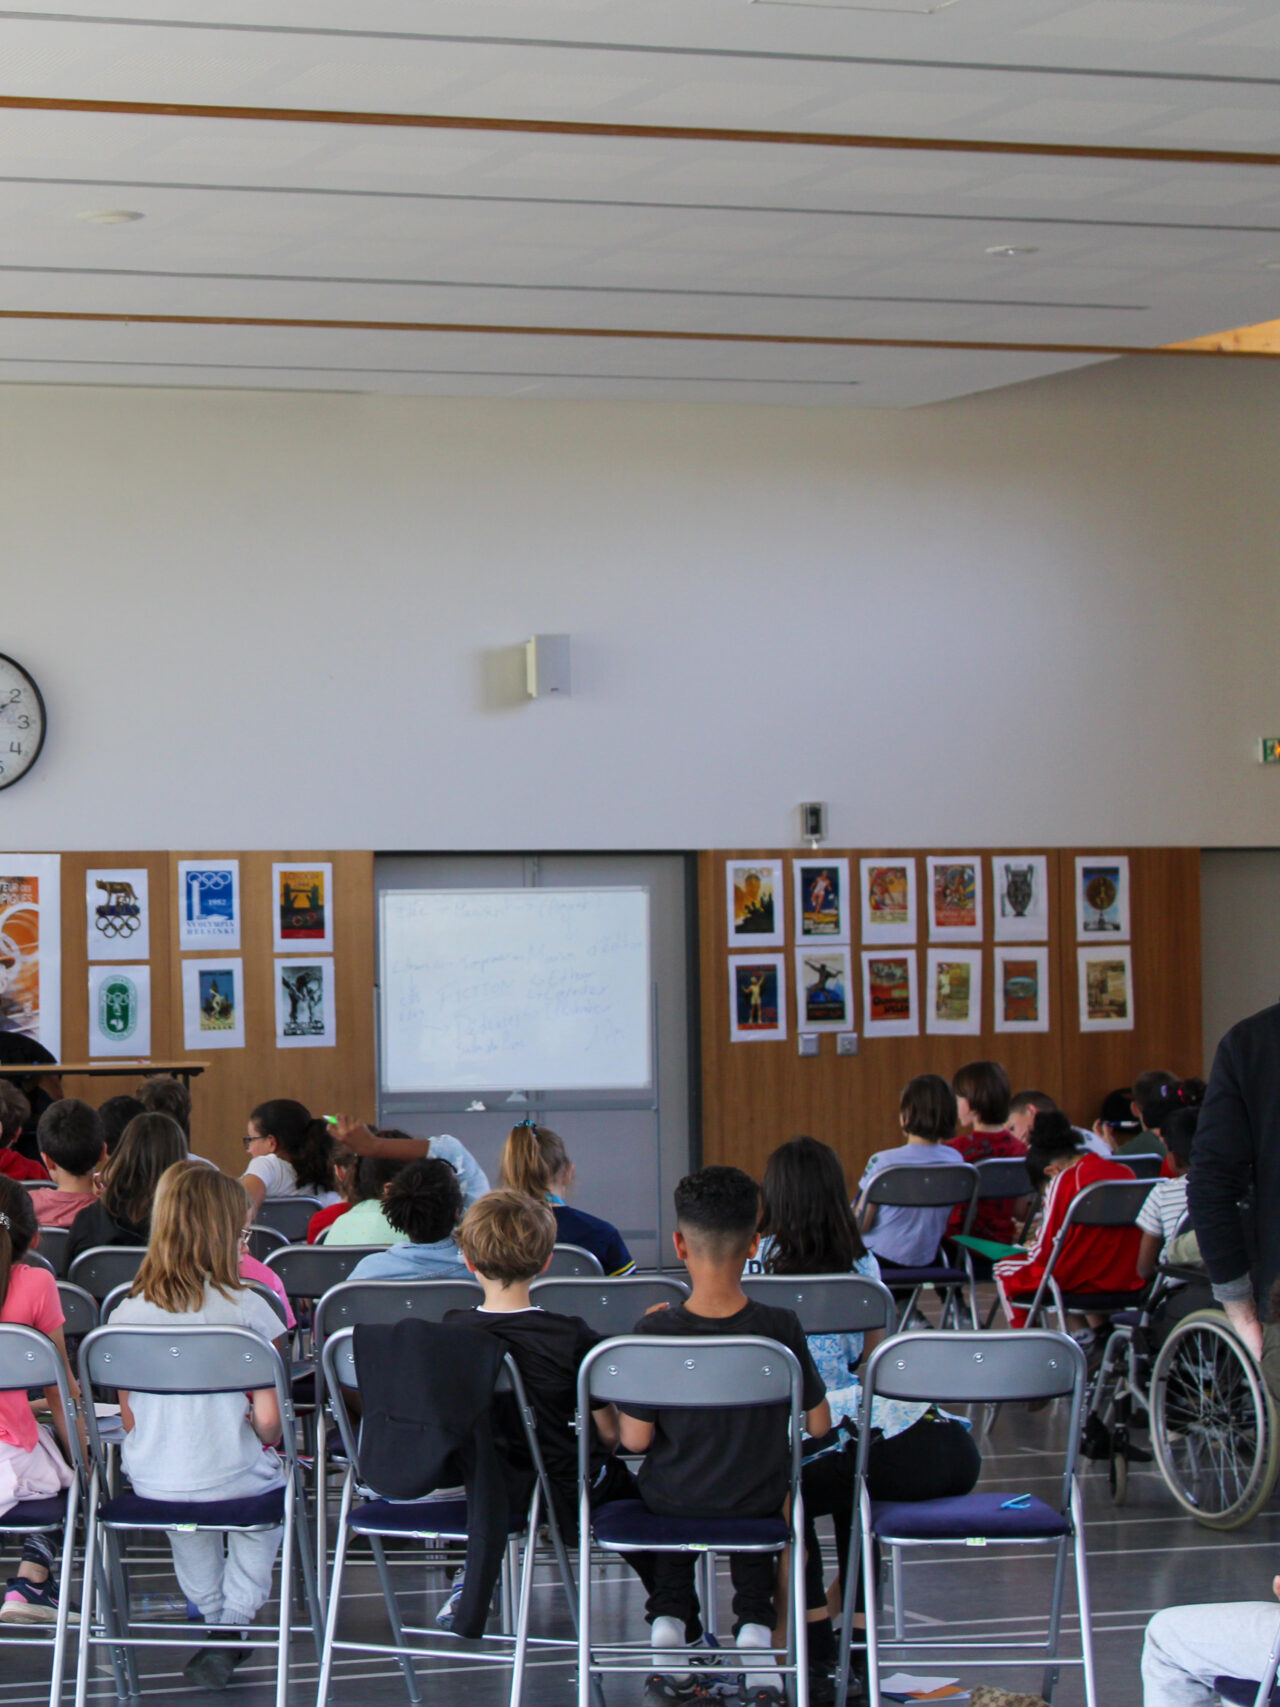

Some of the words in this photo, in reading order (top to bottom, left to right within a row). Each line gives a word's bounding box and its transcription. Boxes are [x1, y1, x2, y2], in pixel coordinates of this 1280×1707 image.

[9, 688, 21, 704] 2
[17, 715, 30, 730] 3
[9, 741, 22, 756] 4
[186, 927, 235, 936] HELSINKI
